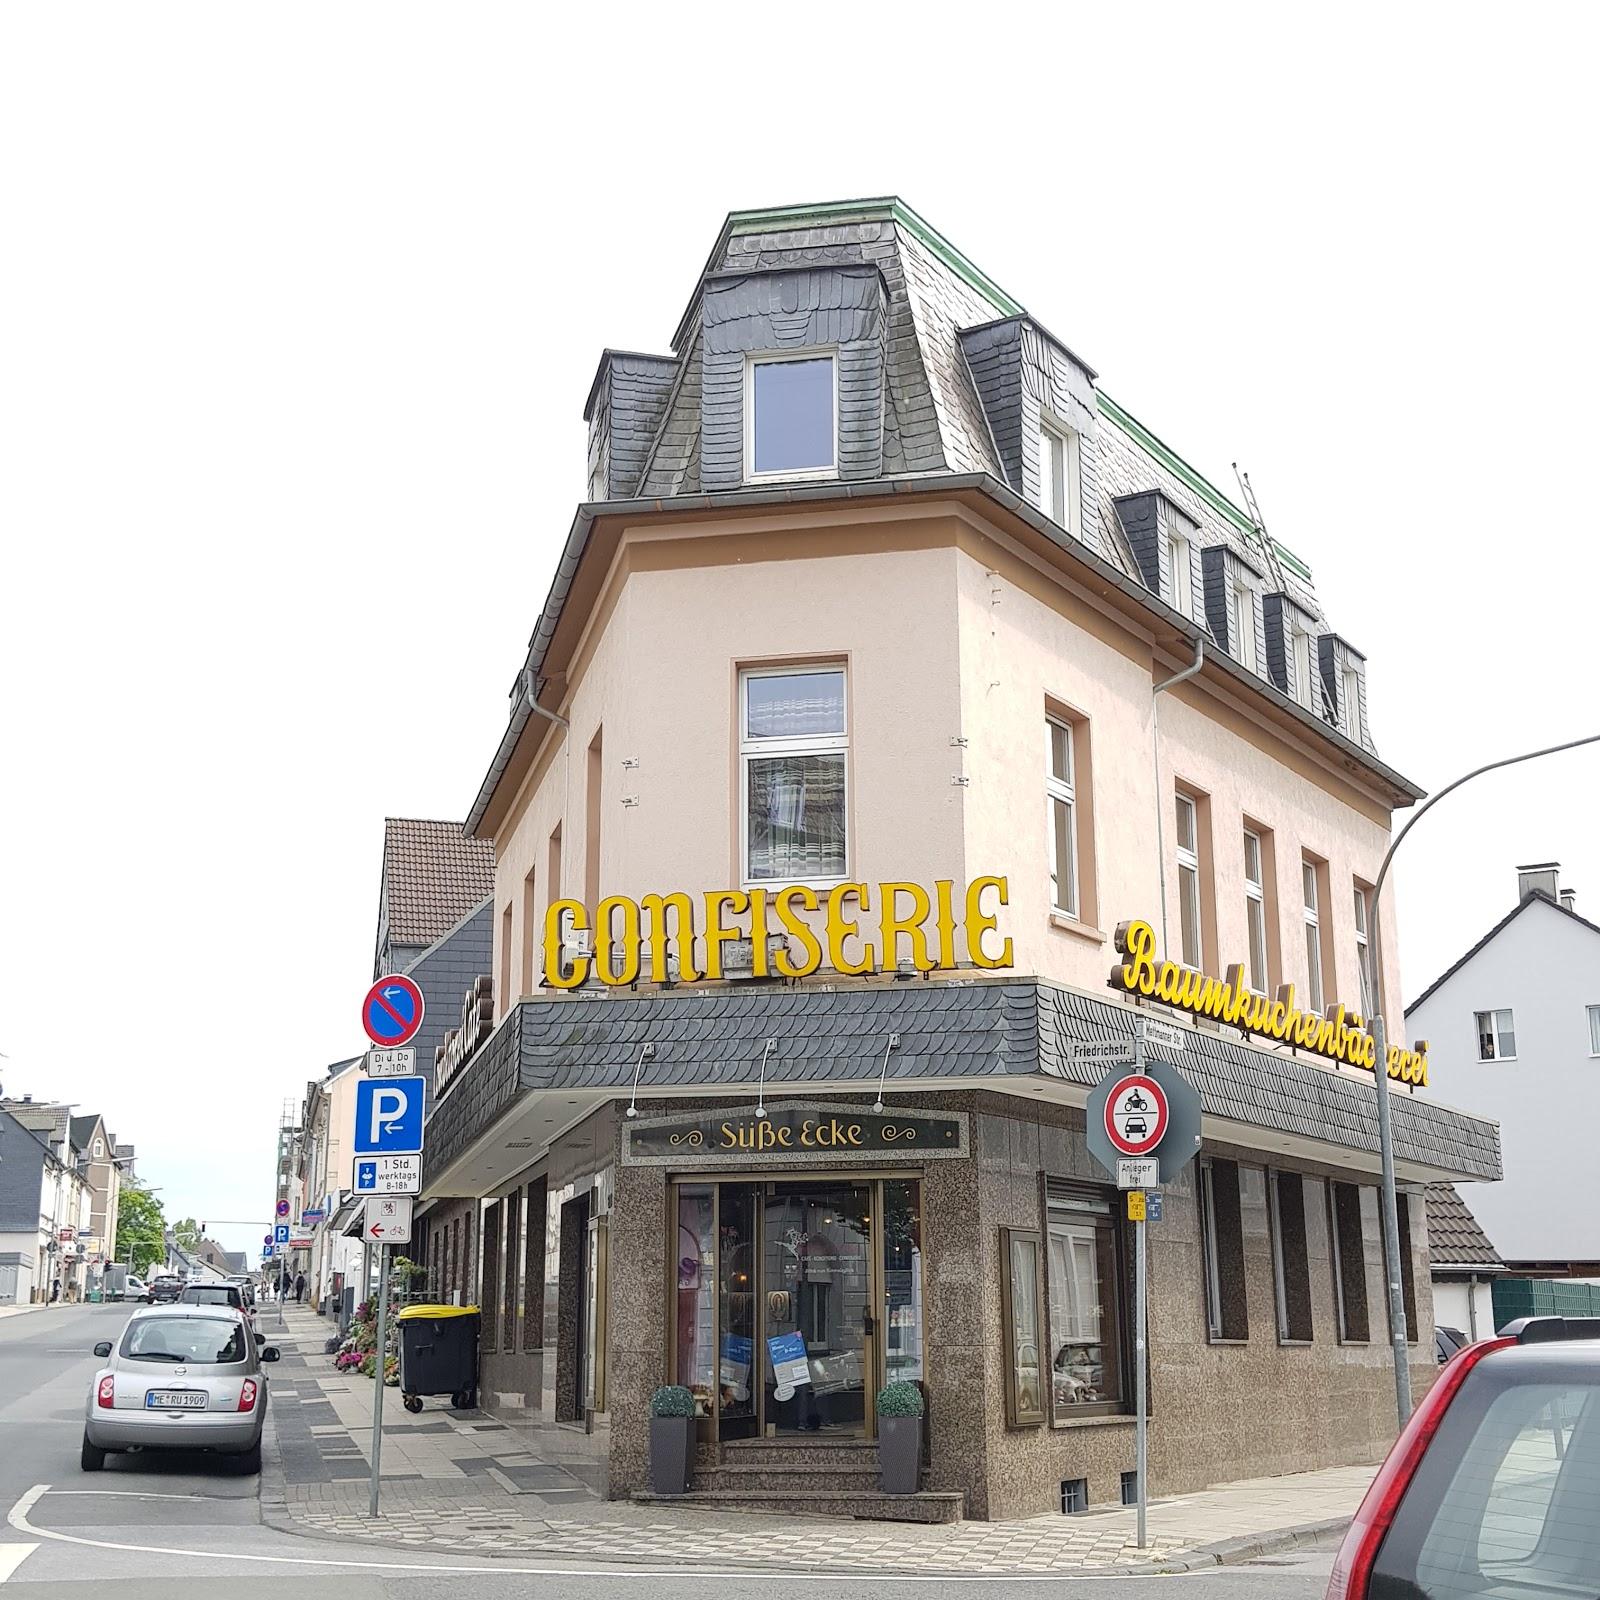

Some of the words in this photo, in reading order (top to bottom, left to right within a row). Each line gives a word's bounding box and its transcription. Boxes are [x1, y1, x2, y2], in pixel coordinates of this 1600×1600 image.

[541, 875, 1014, 990] CONFISERIE
[1123, 919, 1429, 1087] Baumkuchenbäcerei
[1074, 1043, 1130, 1058] Friedrichstr.
[375, 1053, 384, 1063] Di
[397, 1052, 409, 1062] Do
[392, 1063, 407, 1073] 10h
[370, 1087, 408, 1144] P
[719, 1120, 794, 1151] Süße
[800, 1119, 864, 1146] Ecke
[384, 1159, 388, 1169] 1
[392, 1158, 412, 1170] Std.
[1121, 1163, 1153, 1175] Anlieger
[378, 1171, 417, 1182] werktags
[1129, 1174, 1142, 1184] frei
[386, 1181, 408, 1190] 8-18h
[171, 1395, 182, 1405] RU
[183, 1396, 205, 1406] 1909
